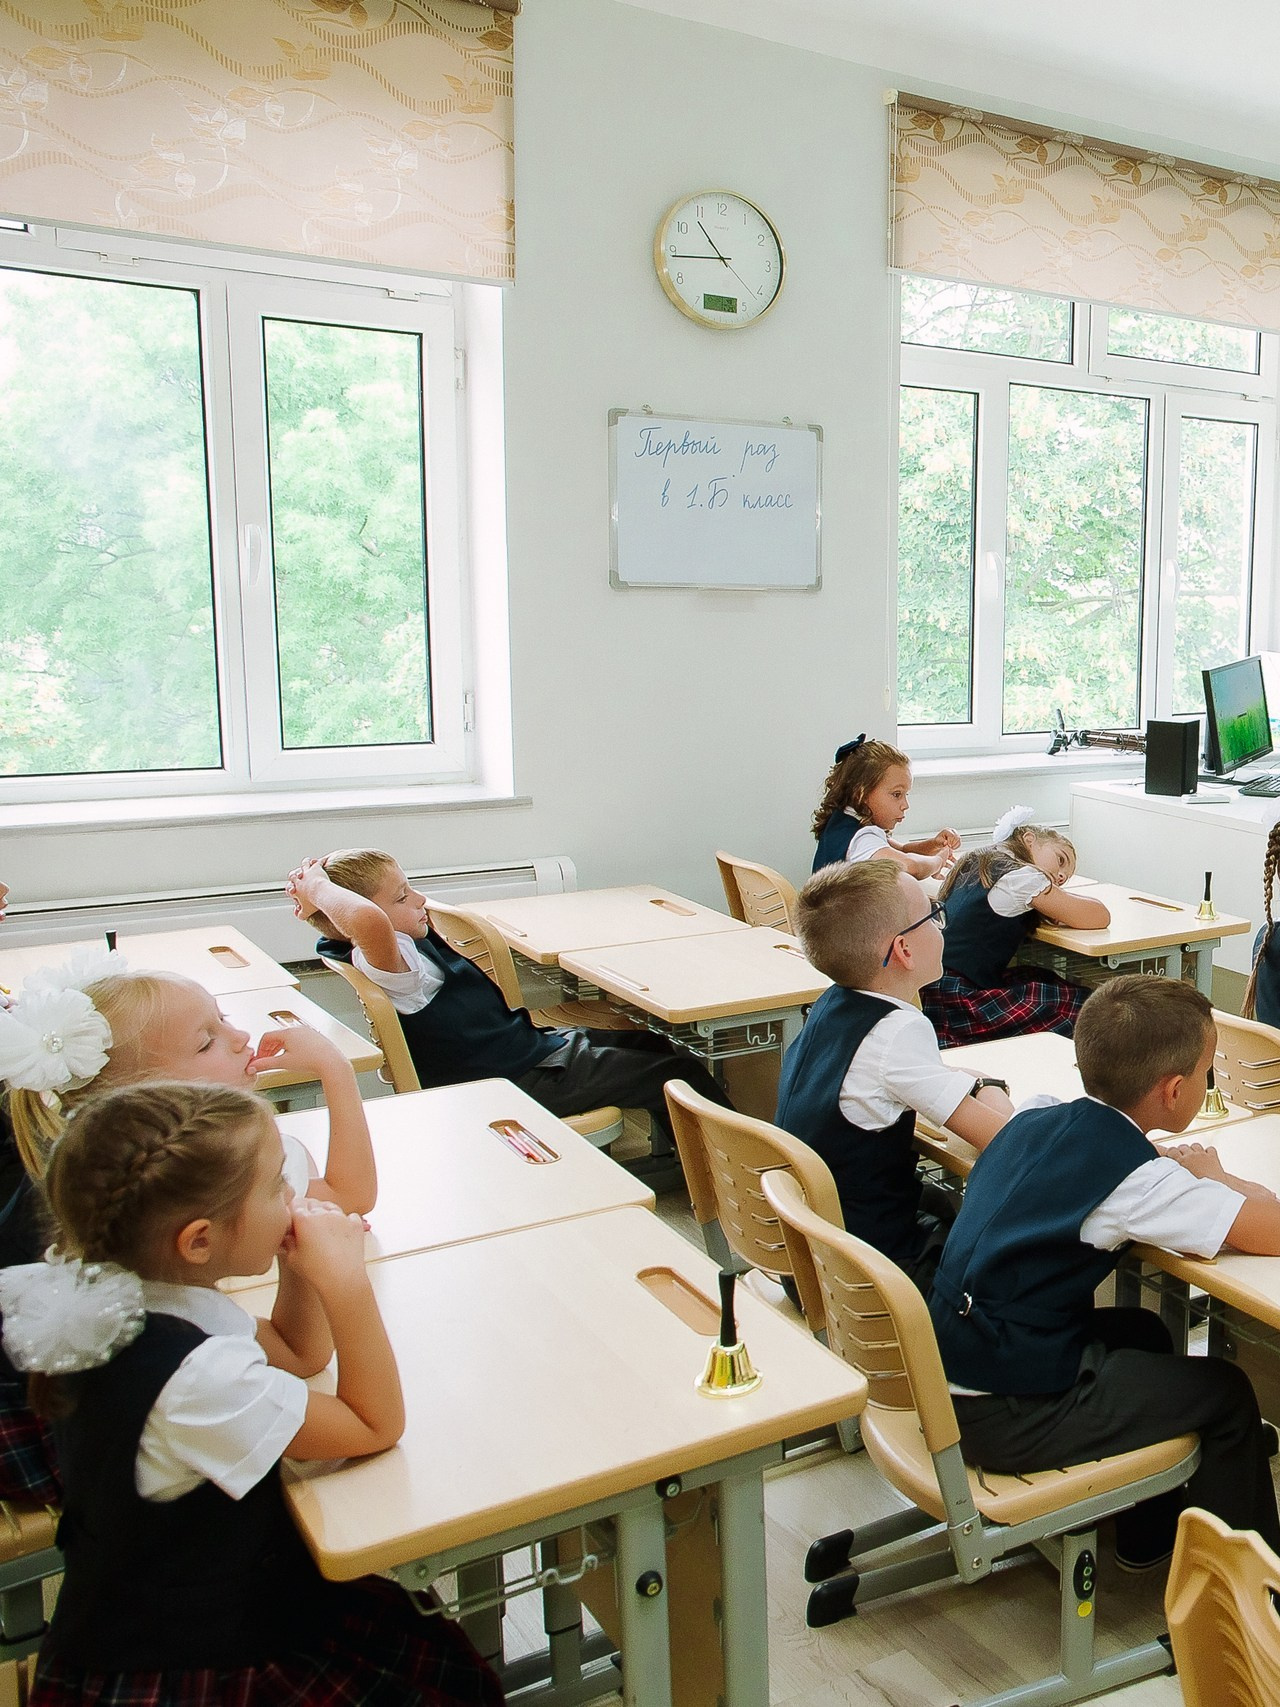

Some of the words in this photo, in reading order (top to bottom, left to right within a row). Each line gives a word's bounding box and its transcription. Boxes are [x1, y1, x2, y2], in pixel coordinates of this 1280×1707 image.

[696, 205, 704, 218] 11
[716, 202, 728, 217] 12
[743, 213, 747, 225] 1
[677, 221, 689, 235] 10
[757, 234, 765, 247] 2
[669, 245, 677, 256] 9
[765, 260, 772, 273] 3
[676, 271, 684, 285] 8
[756, 285, 764, 296] 4
[741, 302, 748, 312] 5
[634, 426, 722, 469] Первый
[740, 440, 781, 474] раз
[661, 478, 672, 508] в
[742, 491, 794, 510] класс
